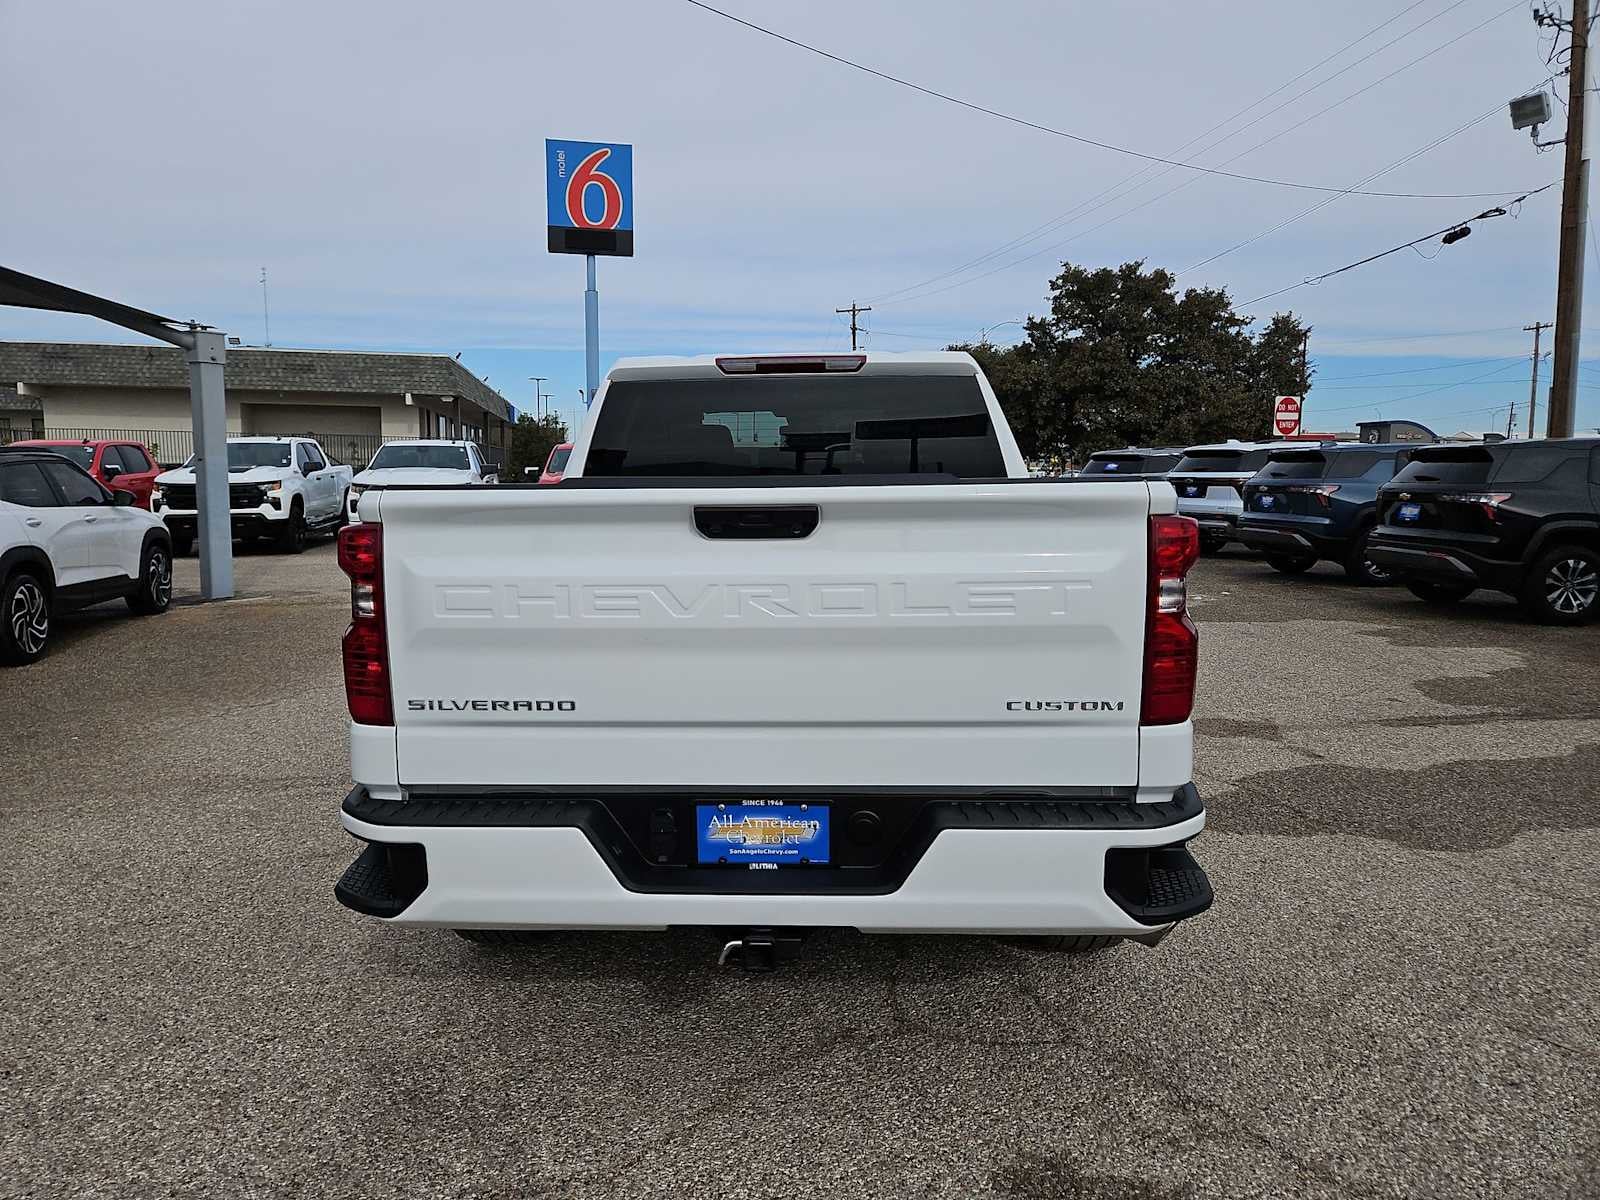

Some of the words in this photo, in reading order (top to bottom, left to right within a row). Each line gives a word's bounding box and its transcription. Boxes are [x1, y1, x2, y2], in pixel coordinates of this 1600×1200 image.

[557, 150, 566, 178] motel
[565, 147, 623, 229] 6
[434, 579, 1093, 618] CHEVROLET
[407, 700, 576, 711] SILVERADO
[1006, 700, 1124, 711] CUSTOM
[708, 814, 733, 829] All
[740, 815, 820, 829] American
[726, 829, 801, 845] Chevrolet
